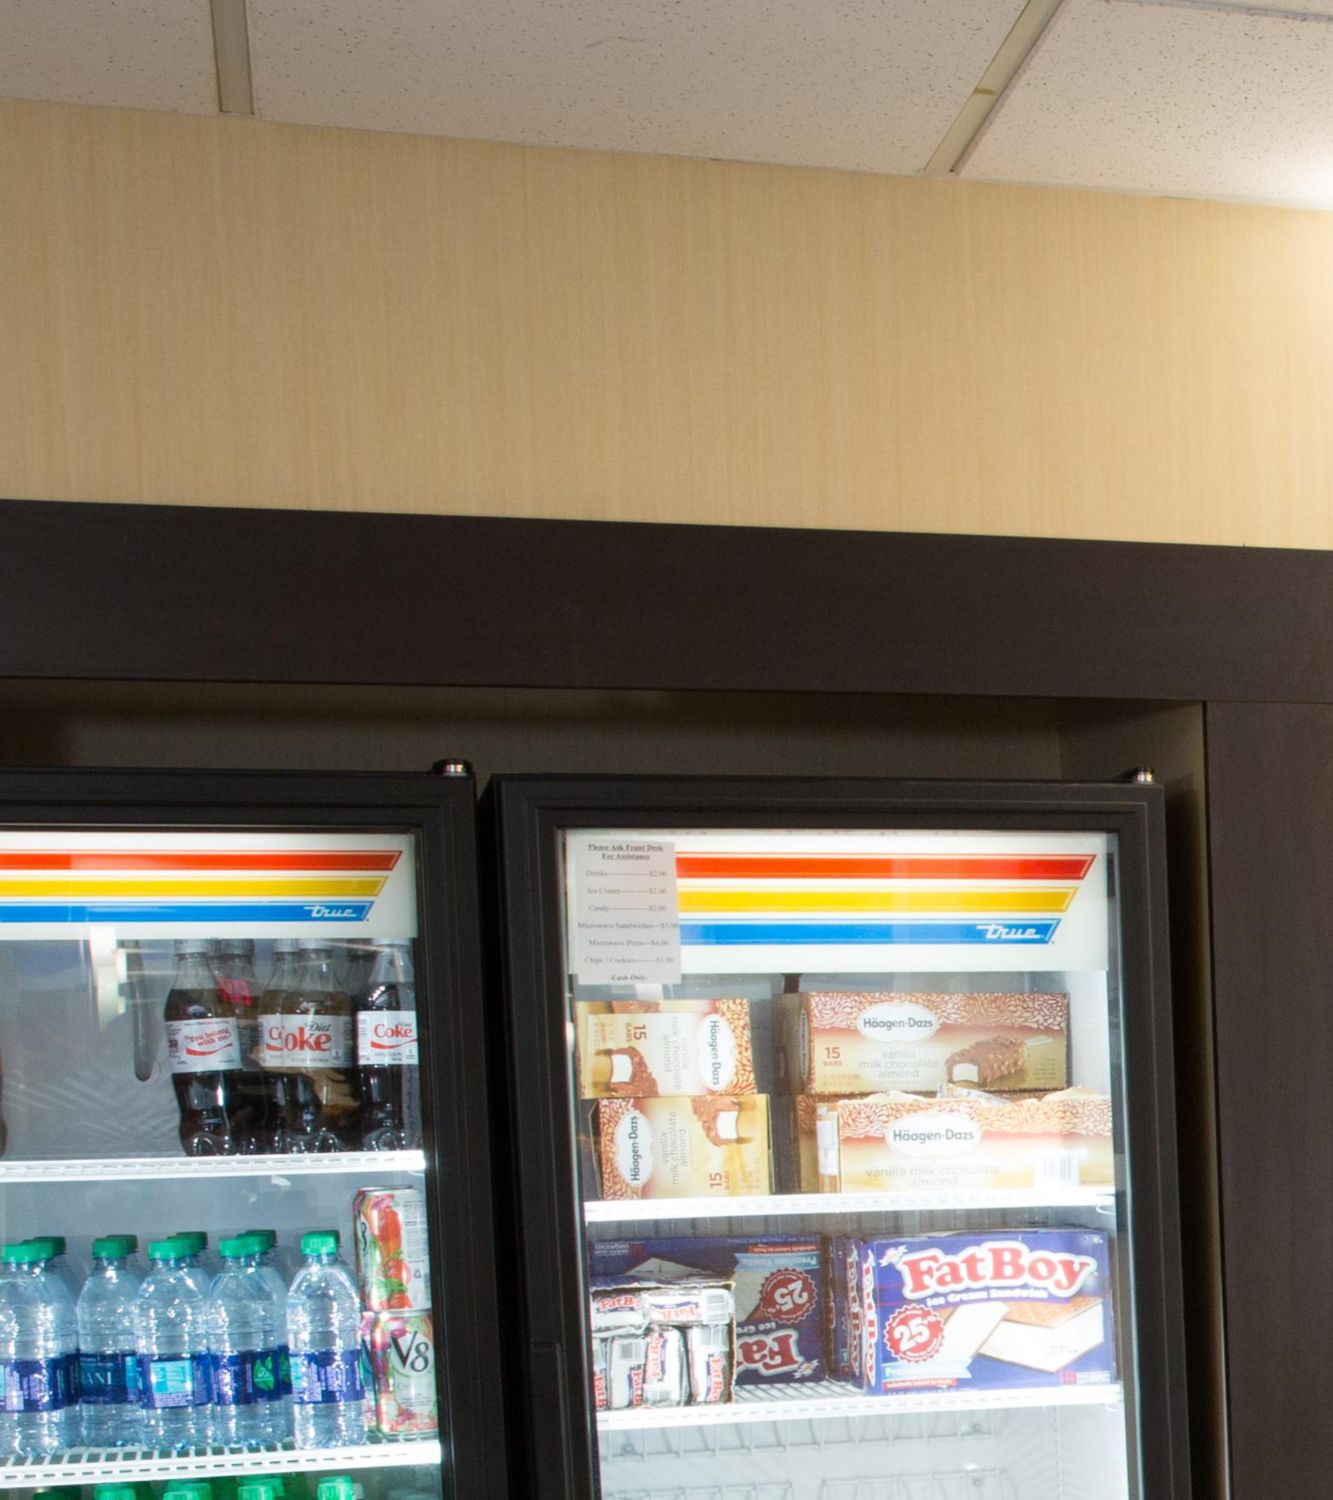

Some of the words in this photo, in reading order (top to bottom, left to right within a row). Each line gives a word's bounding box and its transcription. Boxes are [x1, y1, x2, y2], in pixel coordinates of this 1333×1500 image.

[374, 1023, 413, 1039] Coke
[863, 1017, 934, 1033] Häagen-Dazs
[707, 1019, 722, 1086] Häagen-Dazs
[824, 1046, 841, 1060] 15
[628, 1115, 643, 1182] Häagen-Dazs
[893, 1129, 975, 1144] Häagen-Dazs
[709, 1172, 723, 1189] 15
[773, 1278, 808, 1311] 25
[892, 1319, 929, 1352] 25
[389, 1330, 430, 1373] V8
